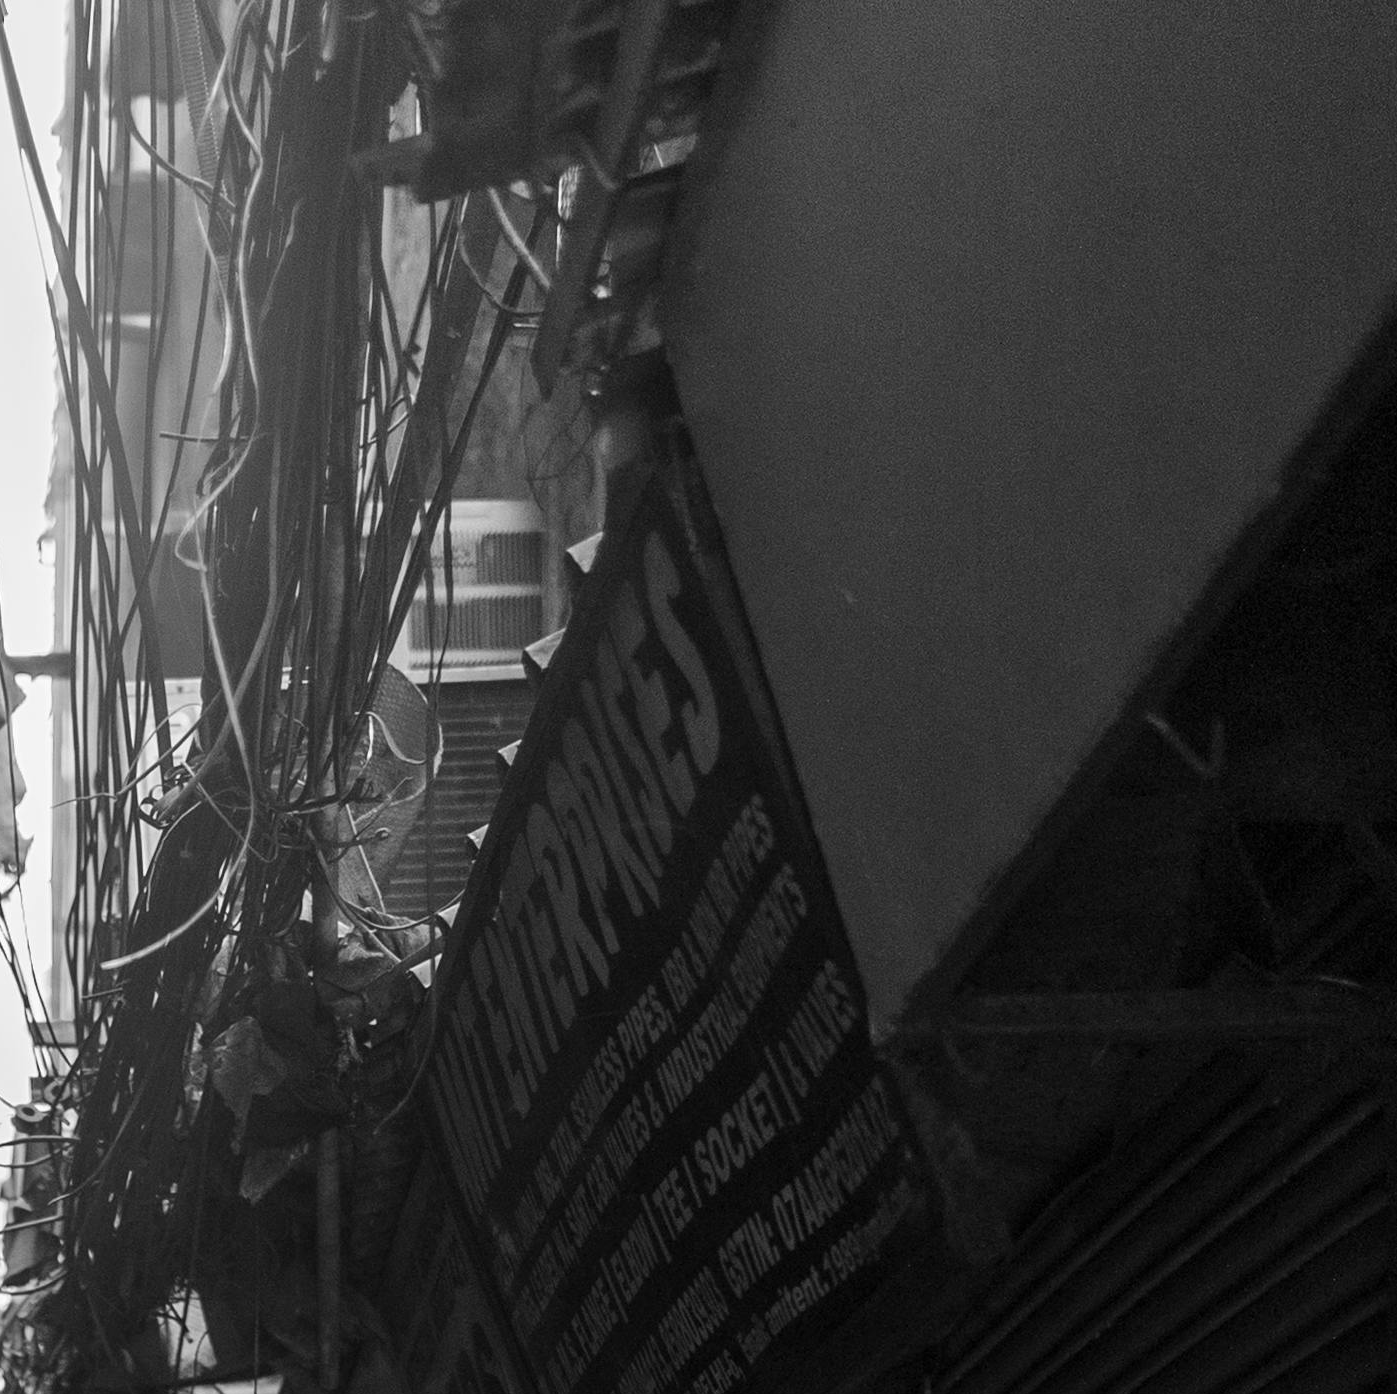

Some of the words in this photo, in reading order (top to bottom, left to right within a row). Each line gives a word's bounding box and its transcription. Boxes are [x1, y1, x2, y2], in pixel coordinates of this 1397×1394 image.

[468, 526, 719, 1119] ENTERPRISES
[721, 789, 776, 893] PIPES
[687, 886, 724, 964] NON
[704, 854, 738, 928] IBR
[603, 1091, 652, 1180] VALVES
[655, 980, 748, 1116] INDUSTRIAL
[728, 859, 808, 1013] EQUIPMENTS
[616, 980, 677, 1071] PIPES,
[660, 944, 697, 1013] IBR
[428, 977, 512, 1227] AMIT
[569, 1031, 627, 1145] SEAMLESS
[570, 1276, 618, 1364] FLANGE
[610, 1215, 658, 1304] ELBOW
[652, 1166, 693, 1241] TEE
[691, 1068, 784, 1199] SOCKET
[787, 955, 858, 1083] VALVES
[716, 1208, 781, 1302] GSTIN:
